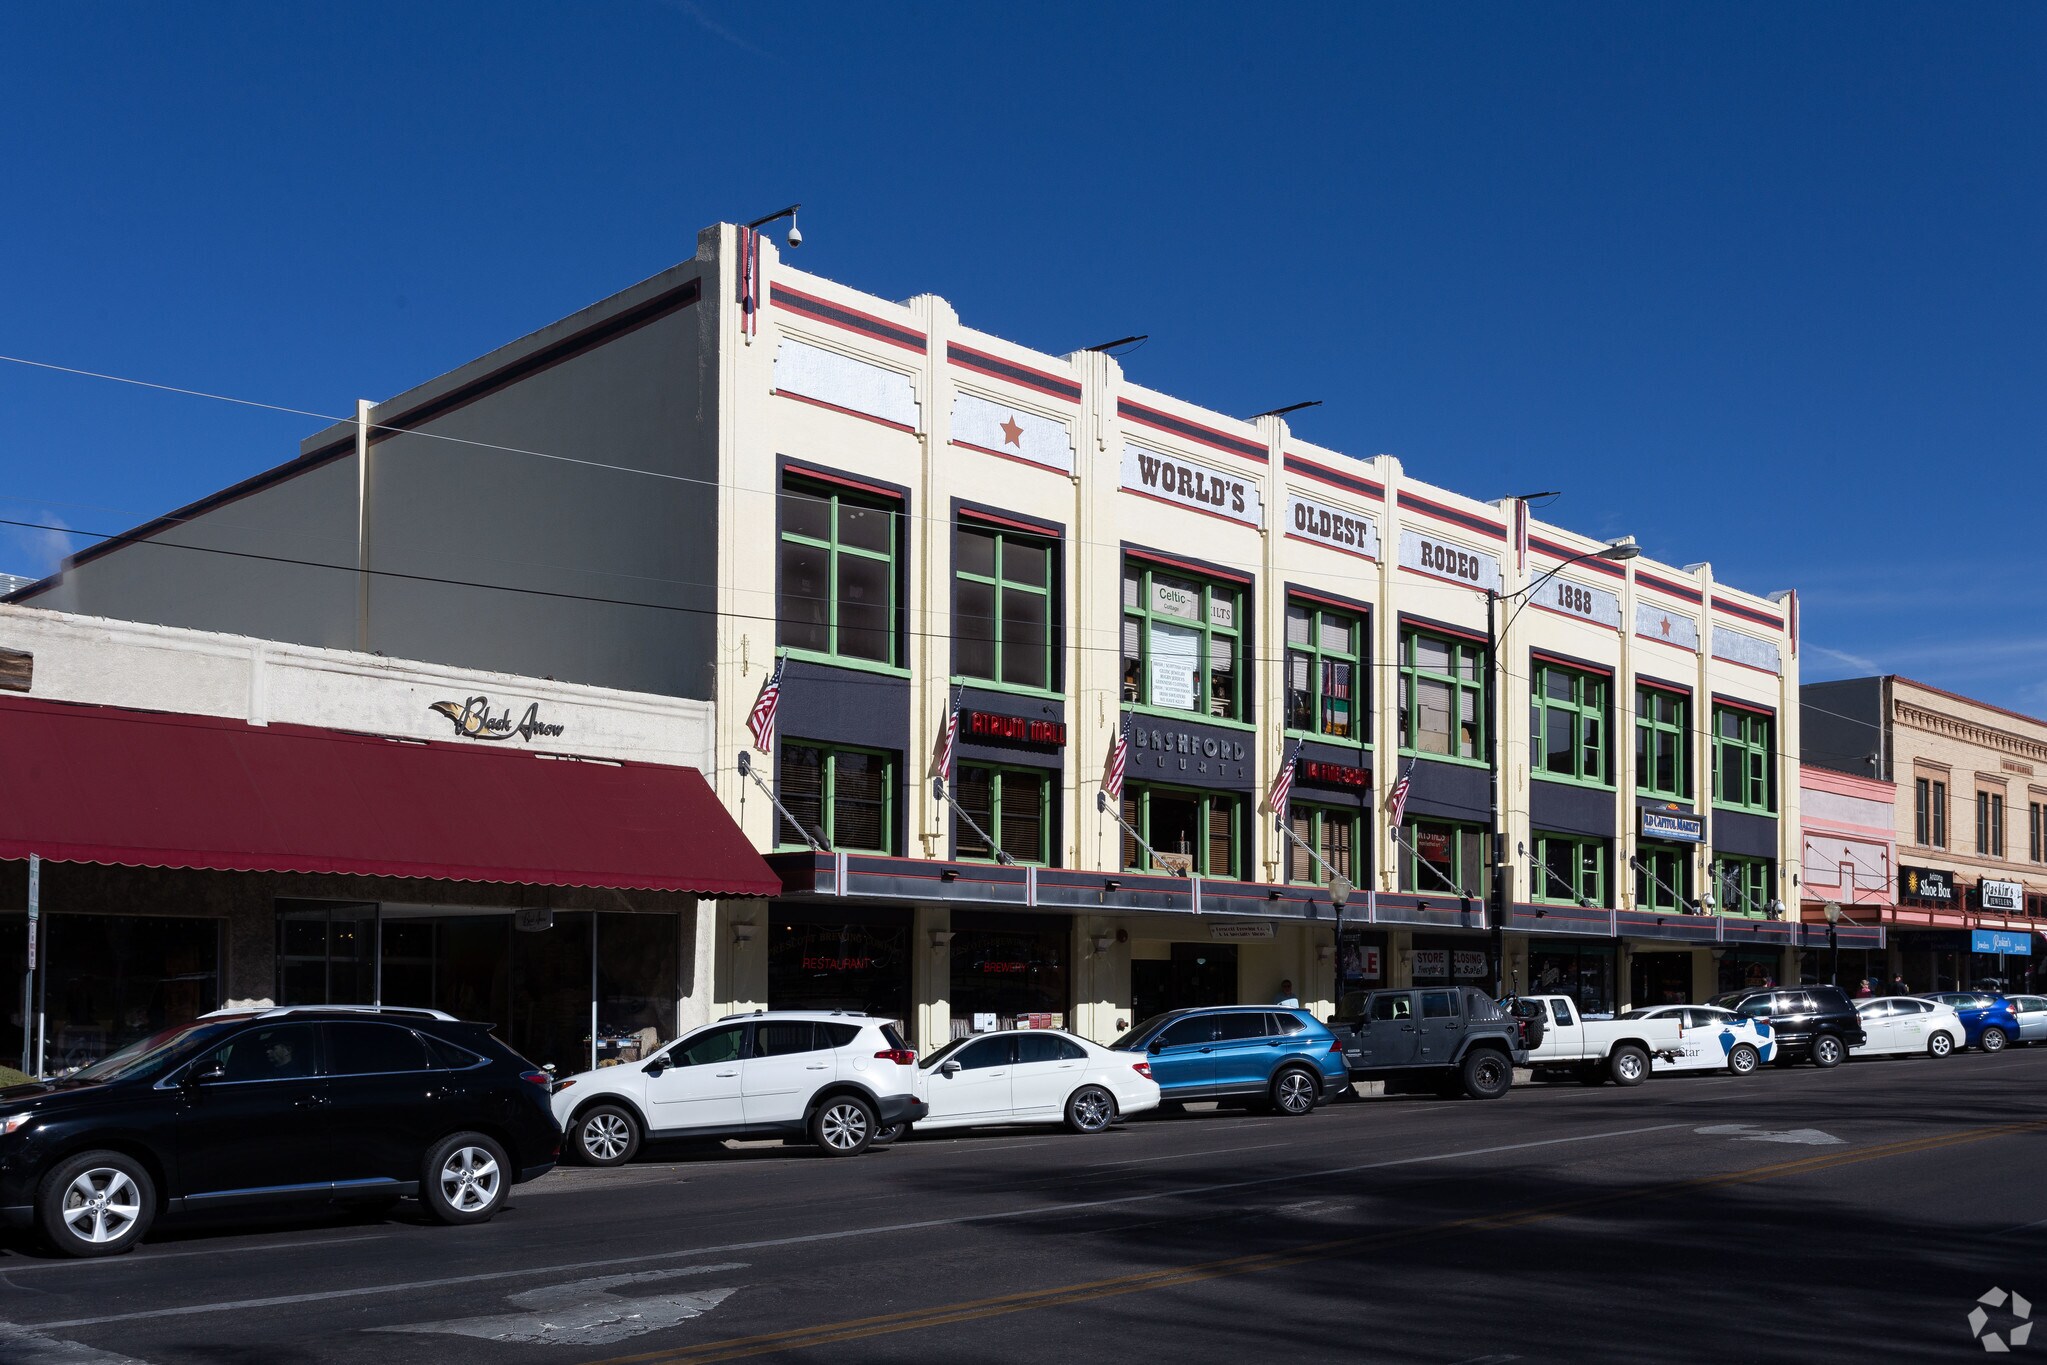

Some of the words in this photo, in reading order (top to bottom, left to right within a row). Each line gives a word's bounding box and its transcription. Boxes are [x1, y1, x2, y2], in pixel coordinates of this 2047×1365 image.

[1137, 453, 1245, 513] WORLD'S
[1294, 502, 1367, 549] OLDEST
[1420, 541, 1479, 581] RODEO
[1557, 583, 1592, 614] 1888
[1159, 588, 1186, 604] Celtic
[1210, 606, 1231, 620] ILTS
[455, 695, 512, 735] Black
[517, 702, 565, 742] Arrow
[972, 711, 1026, 738] ATRIUM
[1030, 720, 1066, 743] MALL
[1135, 727, 1245, 761] BASHFORD
[1644, 814, 1654, 827] LD
[1920, 879, 1938, 897] Shoe
[1937, 884, 1951, 898] Box
[1983, 882, 2014, 905] Raskin's
[1989, 897, 2013, 907] JEWELERS
[802, 957, 871, 970] RESTAURANT
[1417, 952, 1445, 963] STORE
[983, 961, 1026, 973] BREWERY
